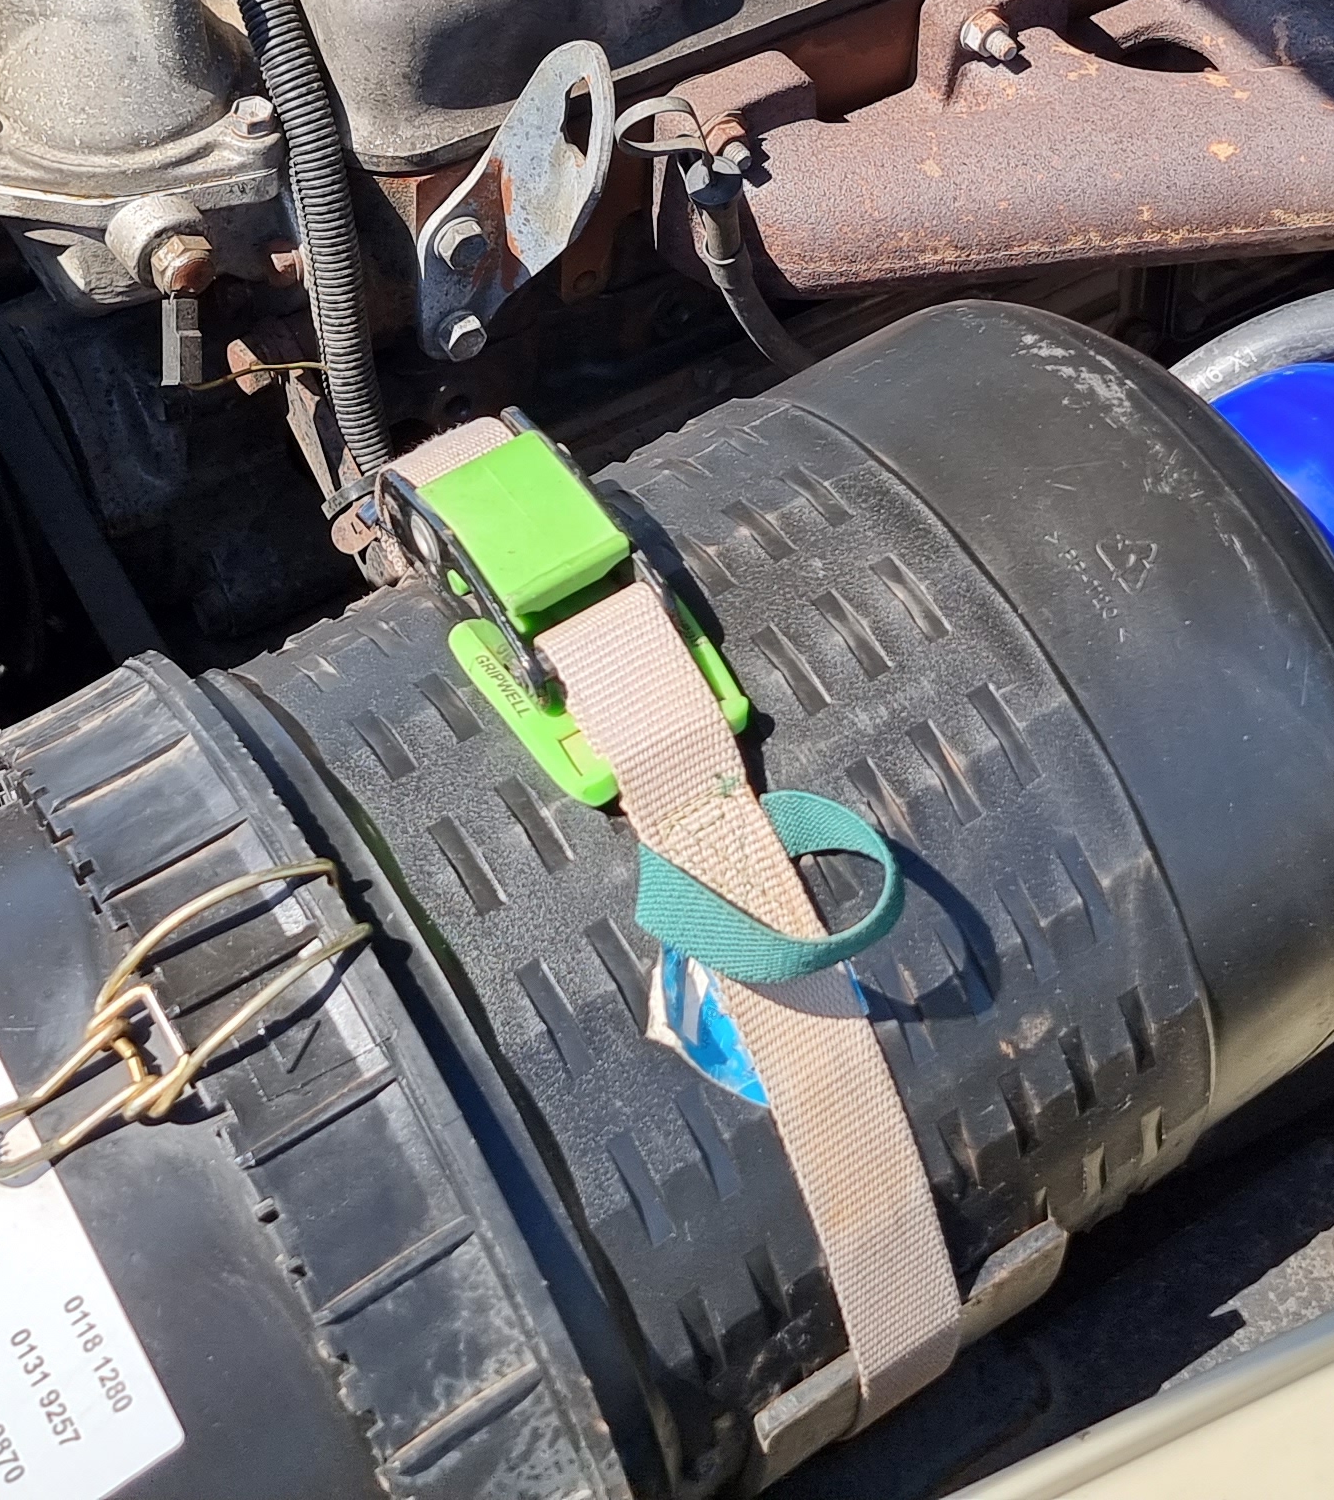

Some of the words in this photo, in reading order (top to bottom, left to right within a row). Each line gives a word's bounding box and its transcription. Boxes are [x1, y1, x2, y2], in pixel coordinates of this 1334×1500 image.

[474, 652, 532, 719] GRIPWELL
[10, 1327, 51, 1388] 0131
[39, 1388, 83, 1449] 9257
[63, 1294, 105, 1354] 0118
[91, 1353, 134, 1415] 1280
